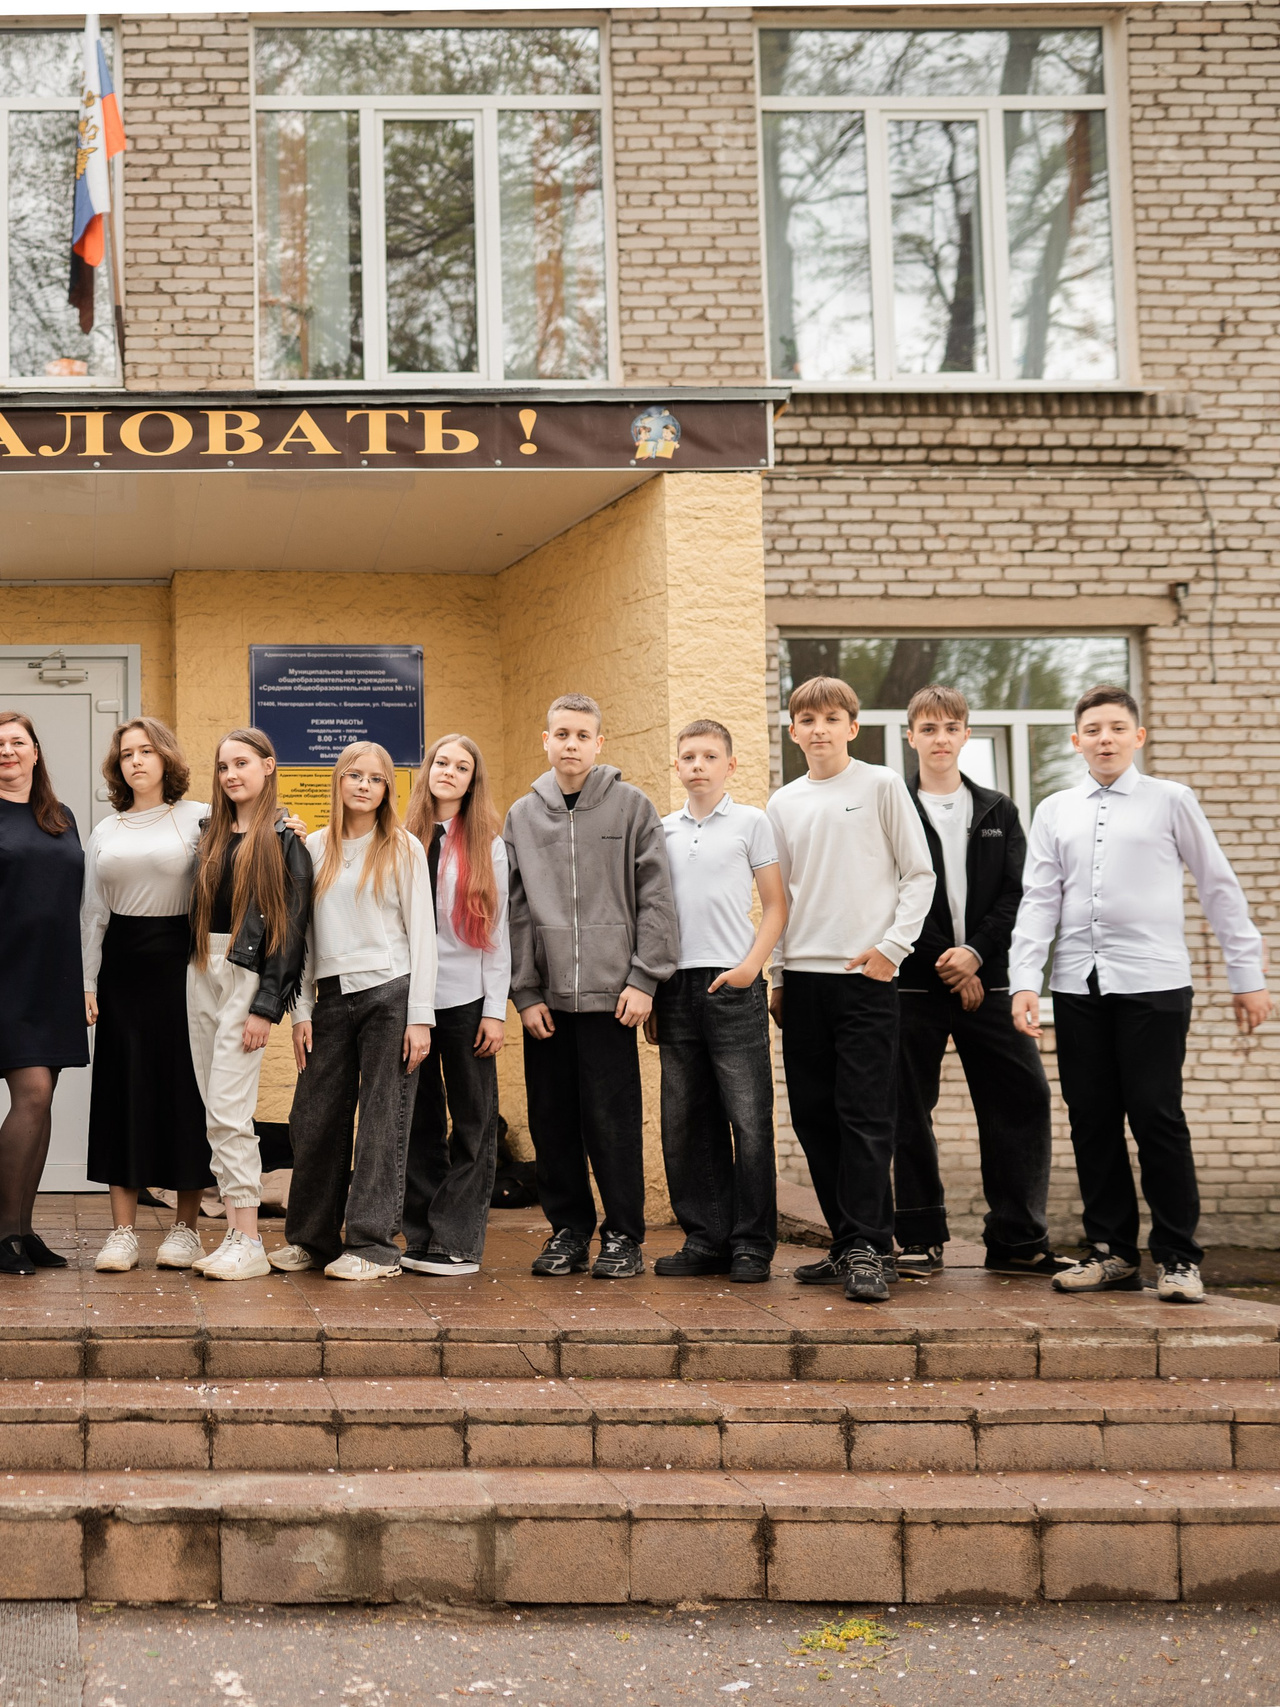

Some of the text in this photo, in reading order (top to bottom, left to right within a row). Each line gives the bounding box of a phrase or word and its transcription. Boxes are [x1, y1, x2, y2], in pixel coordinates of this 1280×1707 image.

[518, 408, 537, 455] !
[288, 668, 344, 676] Муниципальное
[278, 676, 399, 685] общеобразовательное учреждение
[259, 684, 293, 692] «Средняя
[293, 684, 371, 692] общеобразовательная
[317, 735, 333, 743] 8.00
[339, 735, 358, 743] 17.00
[982, 828, 1002, 837] BOSS
